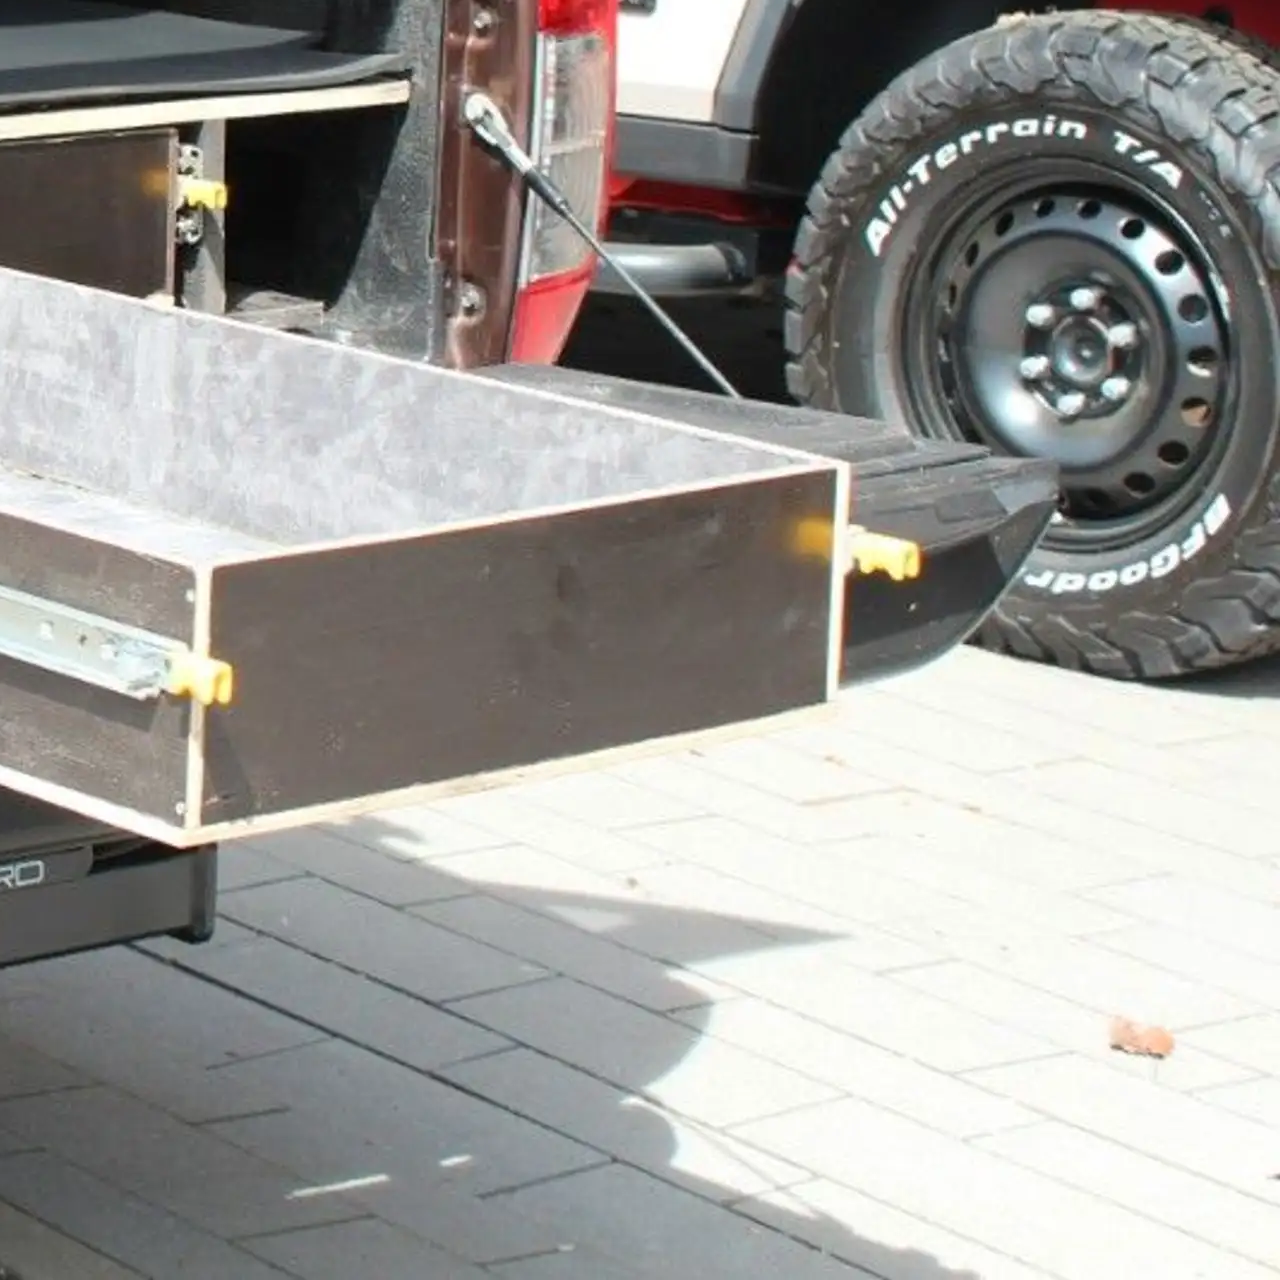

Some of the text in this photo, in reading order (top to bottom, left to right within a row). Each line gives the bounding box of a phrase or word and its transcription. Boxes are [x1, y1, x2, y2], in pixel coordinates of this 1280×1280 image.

[864, 114, 1087, 257] All-Terrain
[1112, 131, 1184, 190] T/A
[1023, 493, 1232, 594] BFGoodr
